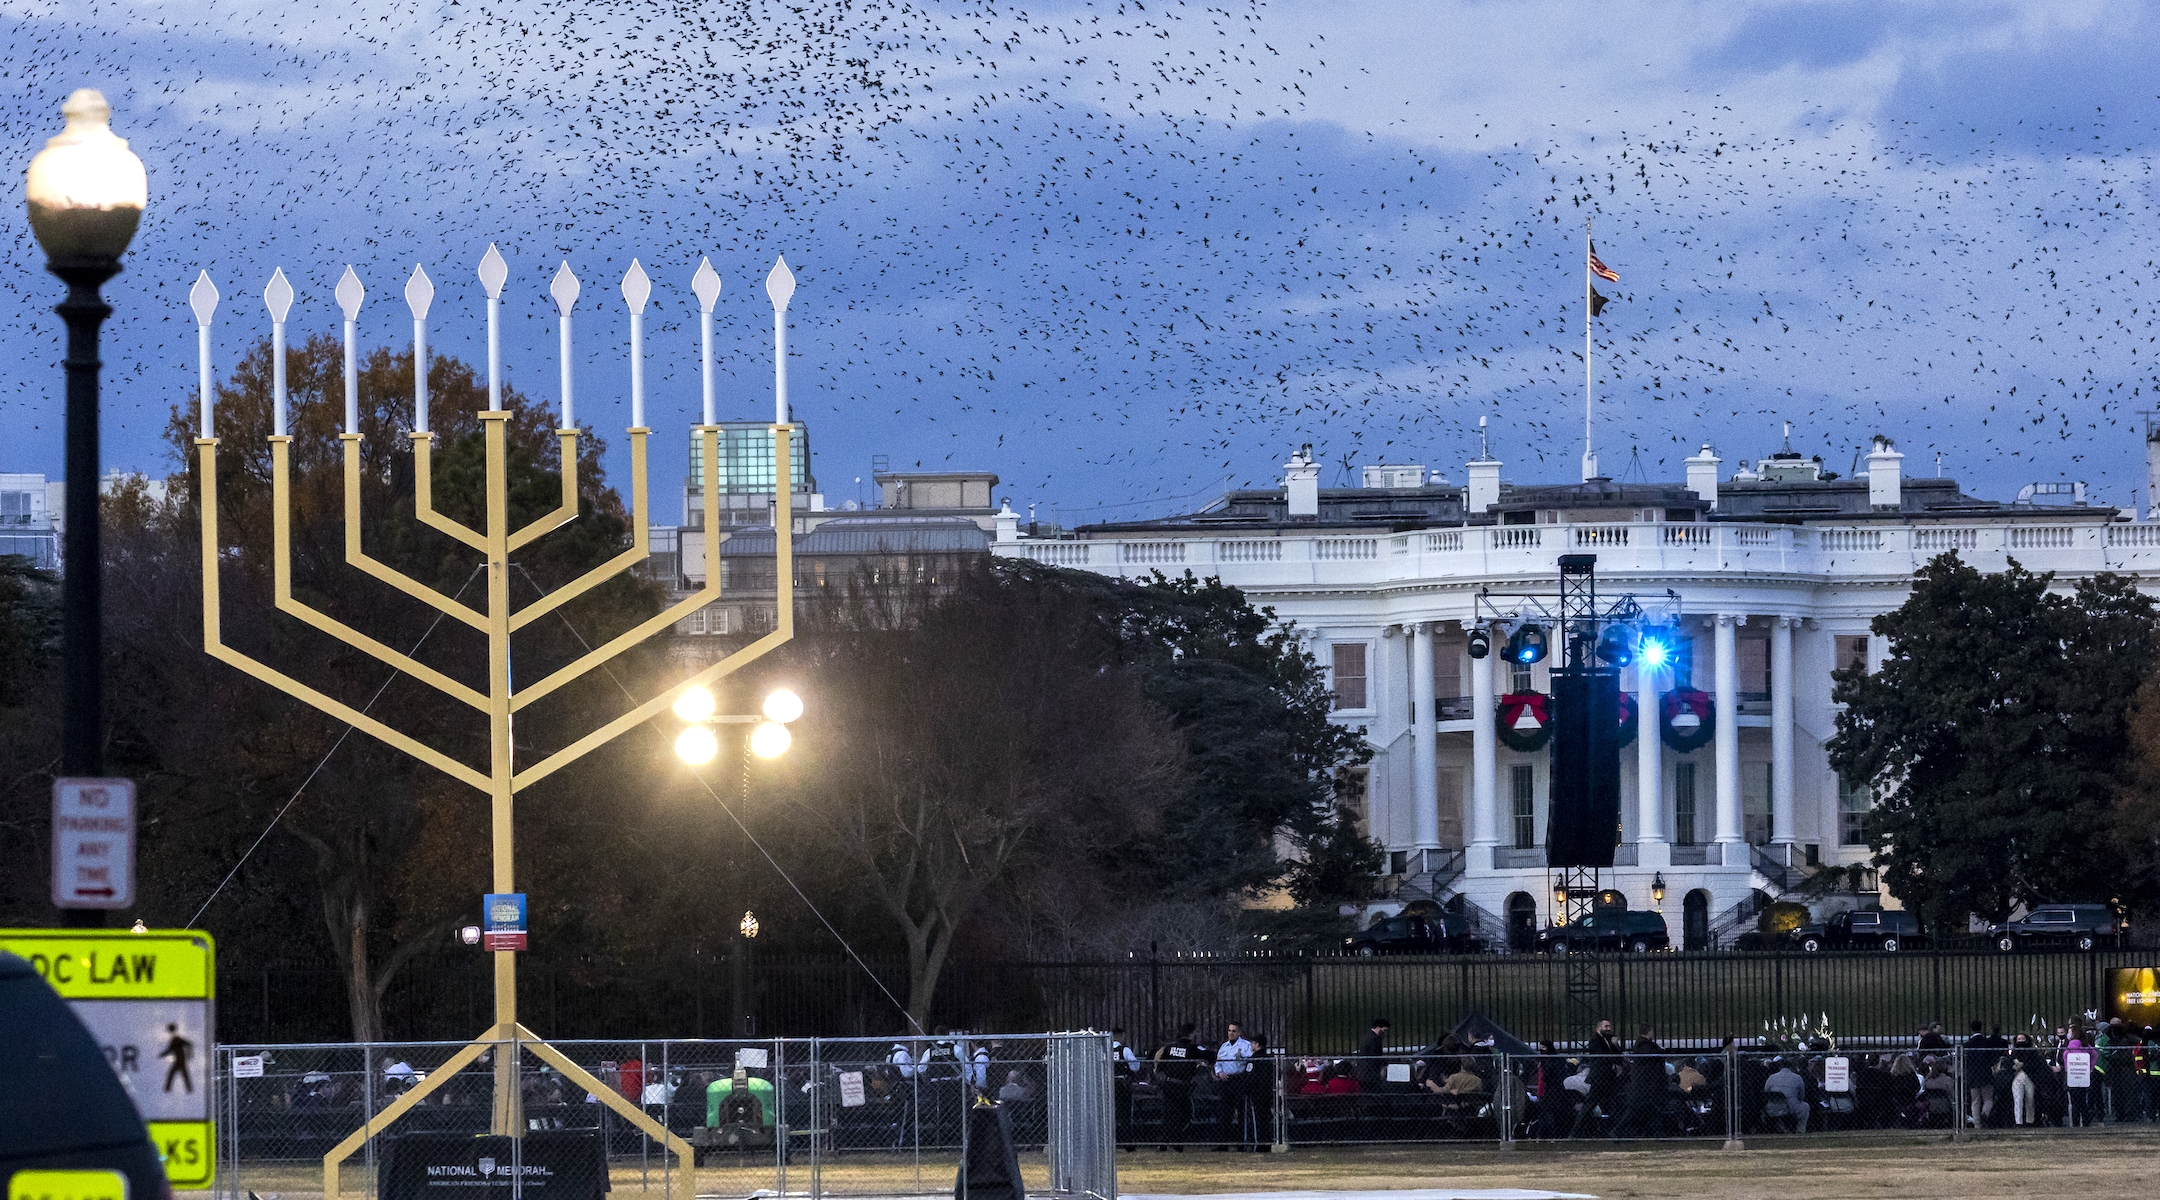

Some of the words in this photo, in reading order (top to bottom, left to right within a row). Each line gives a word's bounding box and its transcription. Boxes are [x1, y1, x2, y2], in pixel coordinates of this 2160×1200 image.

[79, 787, 110, 809] NO
[60, 816, 127, 833] PARKING
[77, 843, 110, 857] ANY
[77, 867, 109, 884] TIME
[89, 951, 157, 984] LAW
[427, 1165, 477, 1176] NATIONAL
